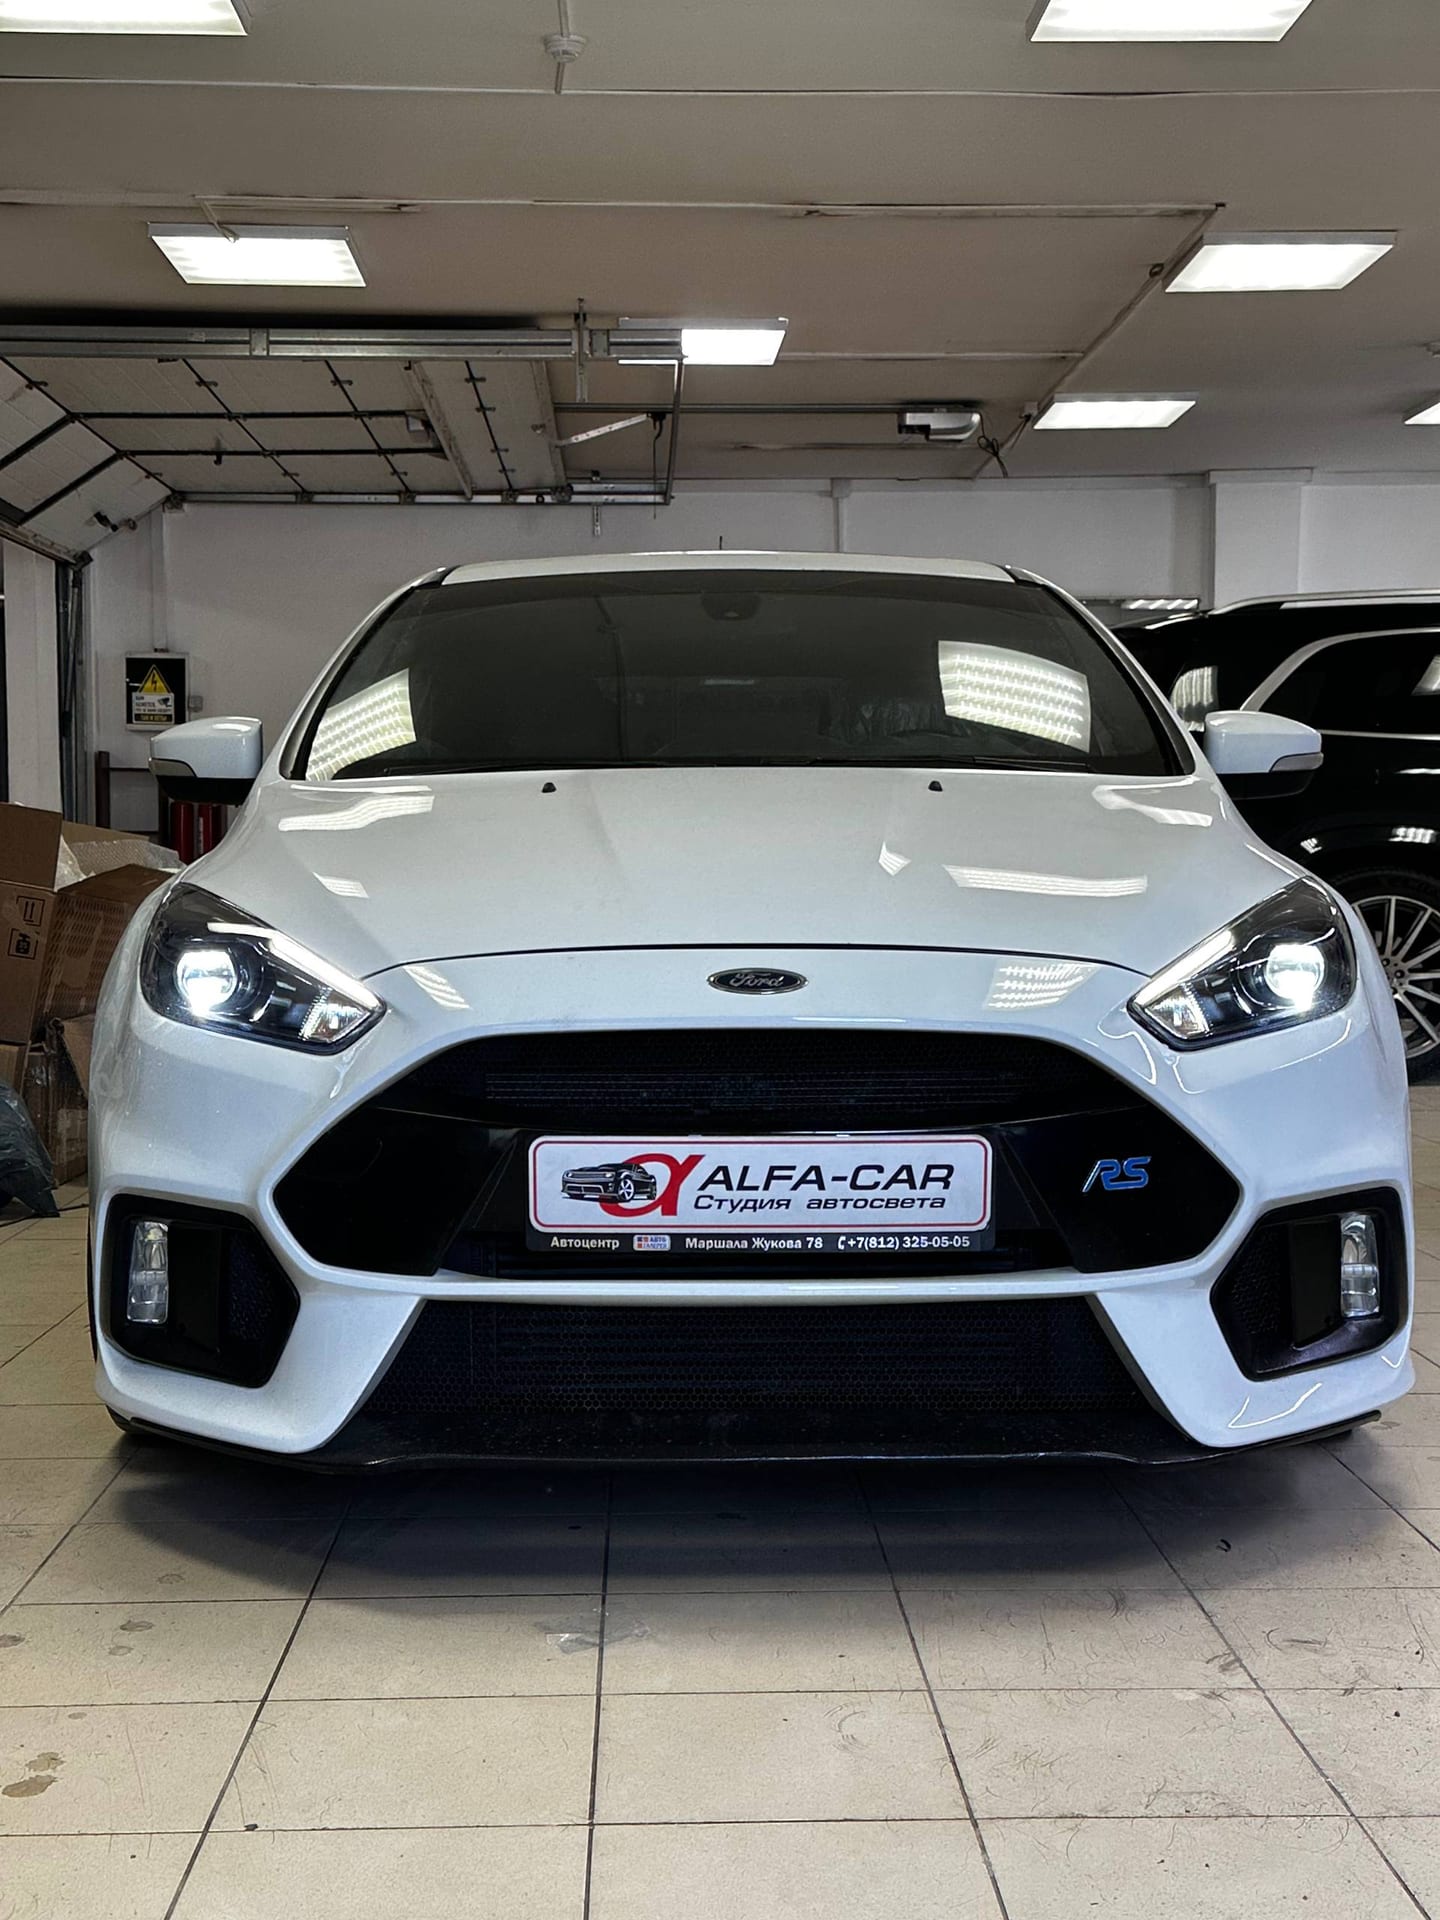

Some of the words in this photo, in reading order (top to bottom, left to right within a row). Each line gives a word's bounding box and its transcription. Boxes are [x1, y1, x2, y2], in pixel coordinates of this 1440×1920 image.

[729, 973, 785, 987] Ford
[697, 1164, 954, 1191] ALFA-CAR
[1082, 1156, 1152, 1192] RS
[693, 1194, 791, 1214] Студия
[806, 1197, 946, 1210] автосвета
[550, 1236, 620, 1250] Автоцентр
[685, 1237, 748, 1250] Маршала
[751, 1237, 802, 1251] Жукова
[806, 1237, 823, 1249] 78
[847, 1236, 899, 1250] +7(812)
[902, 1235, 970, 1248] 325-05-05
